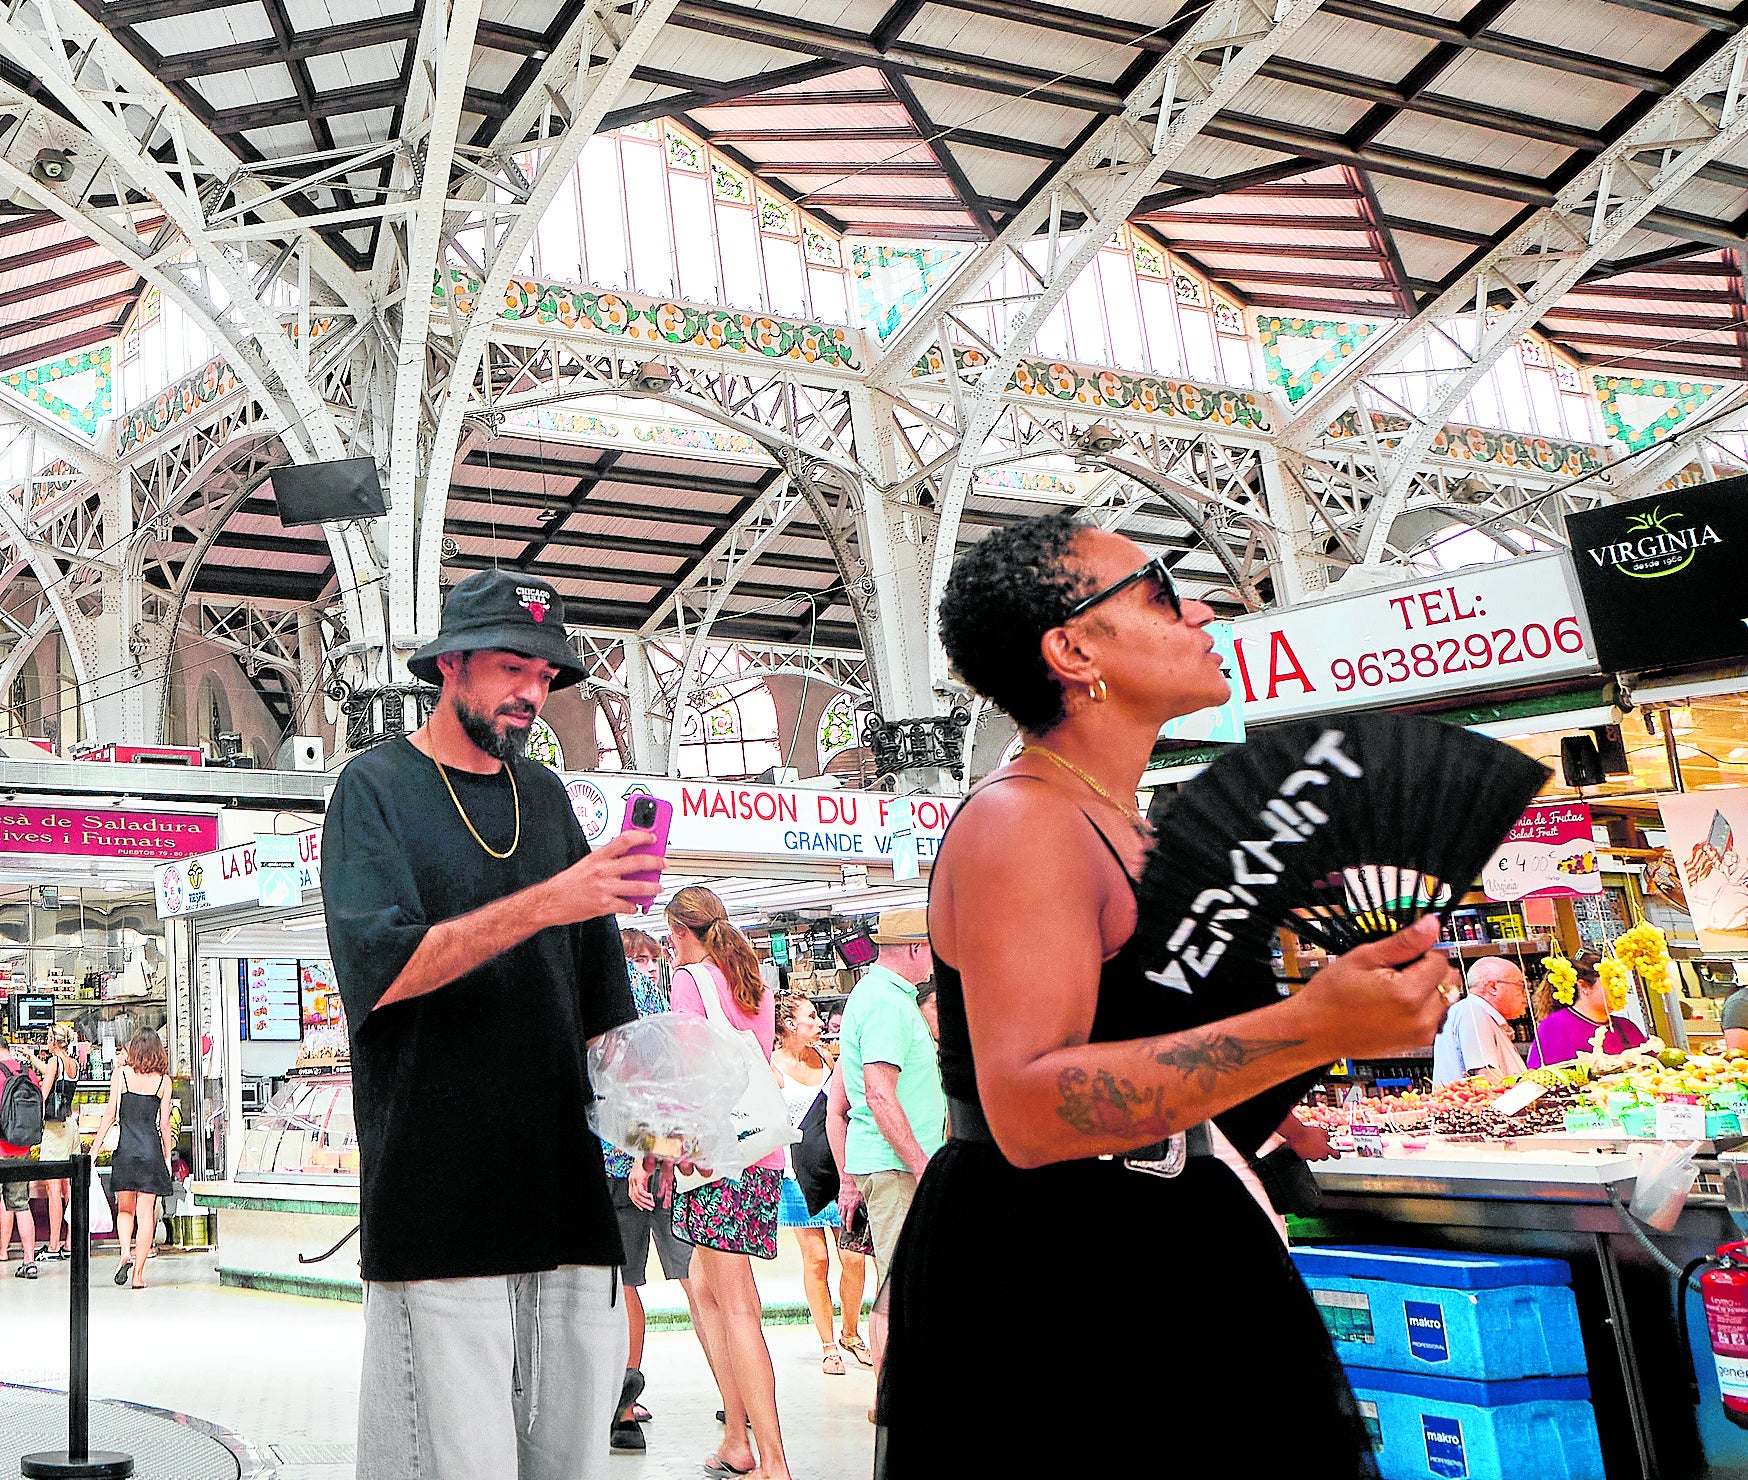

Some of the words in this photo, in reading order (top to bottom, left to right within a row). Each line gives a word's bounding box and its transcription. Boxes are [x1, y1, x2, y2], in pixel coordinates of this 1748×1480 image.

[1587, 524, 1723, 567] VIRGINIA
[1632, 559, 1660, 571] desde
[515, 586, 551, 600] CHICAGO
[1389, 586, 1487, 630] TEL:
[1233, 629, 1317, 703] IA
[1330, 615, 1585, 693] 963829206
[681, 787, 798, 823] MAISON
[817, 795, 857, 826] DU
[0, 813, 32, 826] sà
[41, 813, 72, 828] de
[82, 815, 203, 833] Saladura
[1534, 812, 1548, 825] de
[1549, 810, 1584, 824] Frutas
[0, 829, 53, 843] ives
[63, 832, 70, 844] i
[82, 832, 176, 848] Fumats
[784, 831, 864, 853] GRANDE
[1509, 827, 1535, 840] Salad
[1535, 826, 1559, 838] Fruit
[117, 848, 155, 856] PUESTOS
[221, 853, 241, 880] LA
[1409, 1317, 1441, 1330] makro
[1426, 1431, 1460, 1445] makro
